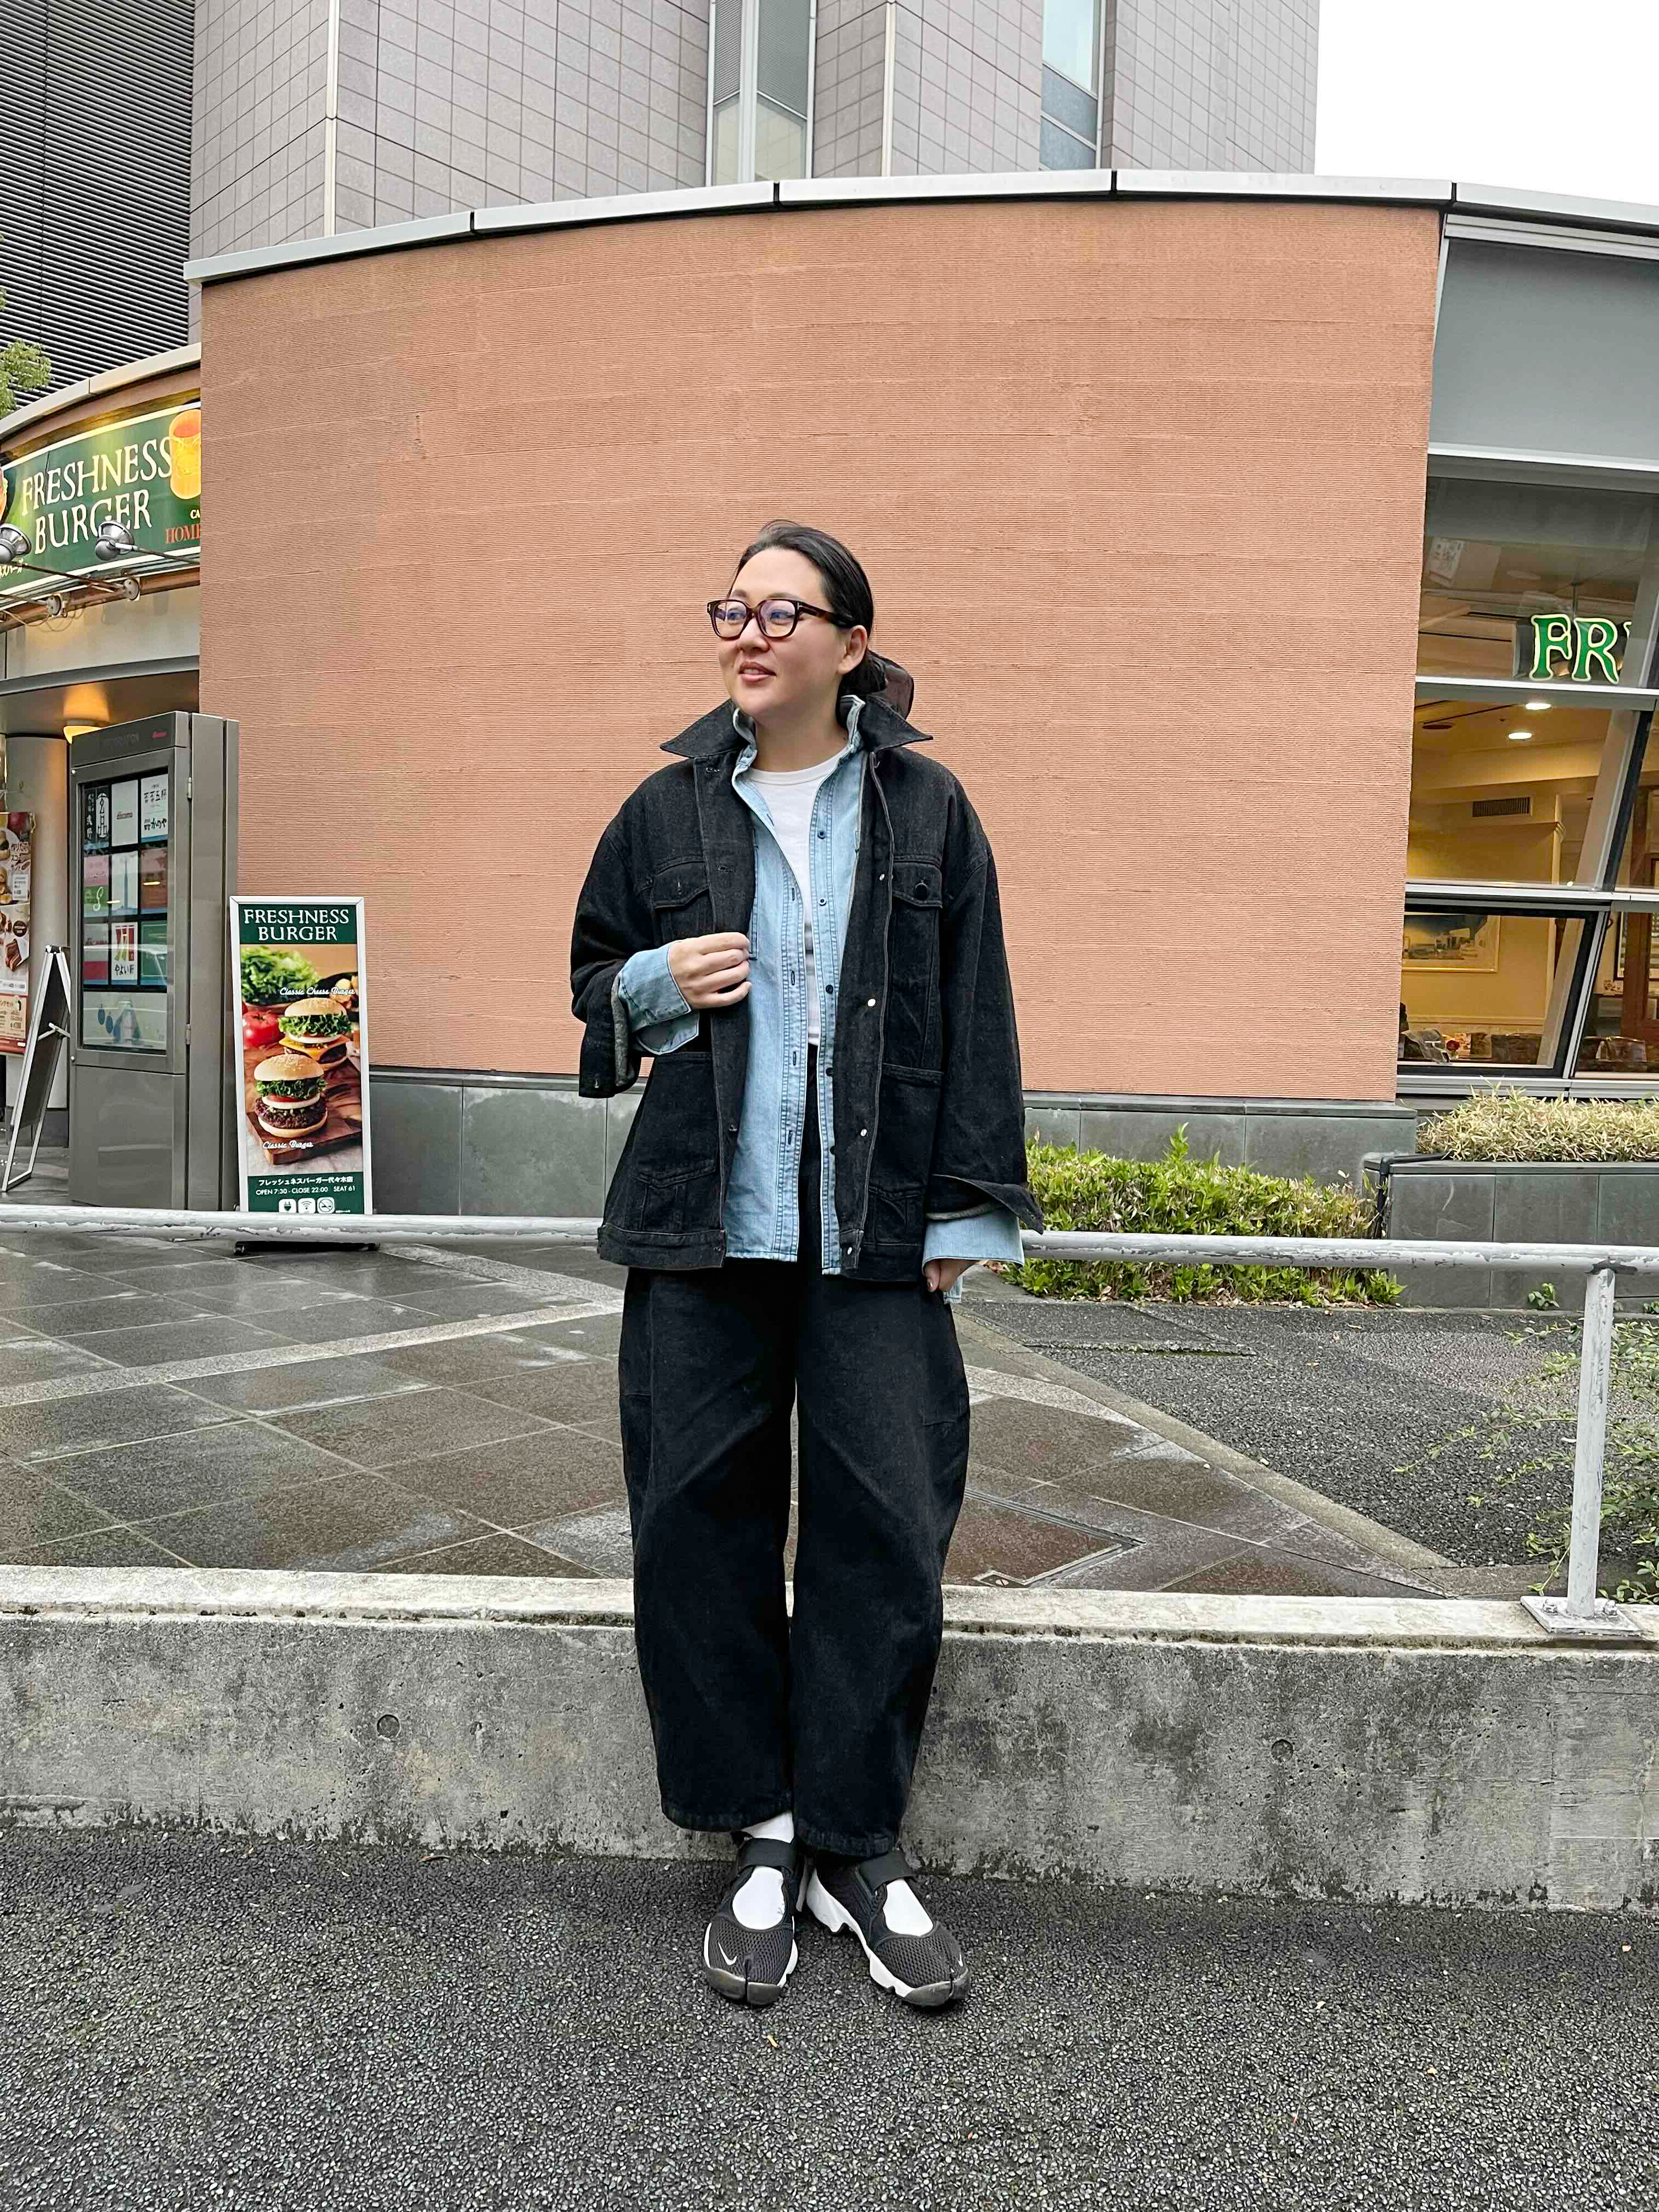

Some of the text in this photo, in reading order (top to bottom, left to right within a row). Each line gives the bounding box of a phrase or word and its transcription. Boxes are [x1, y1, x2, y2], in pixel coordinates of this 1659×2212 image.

[21, 437, 172, 517] FRESHNESS
[34, 489, 152, 555] BURGER
[1529, 613, 1632, 685] FR
[244, 909, 349, 924] FRESHNESS
[258, 926, 337, 941] BURGER
[280, 987, 305, 995] Classic
[331, 986, 356, 995] Burger
[263, 1139, 314, 1149] Classic Burger
